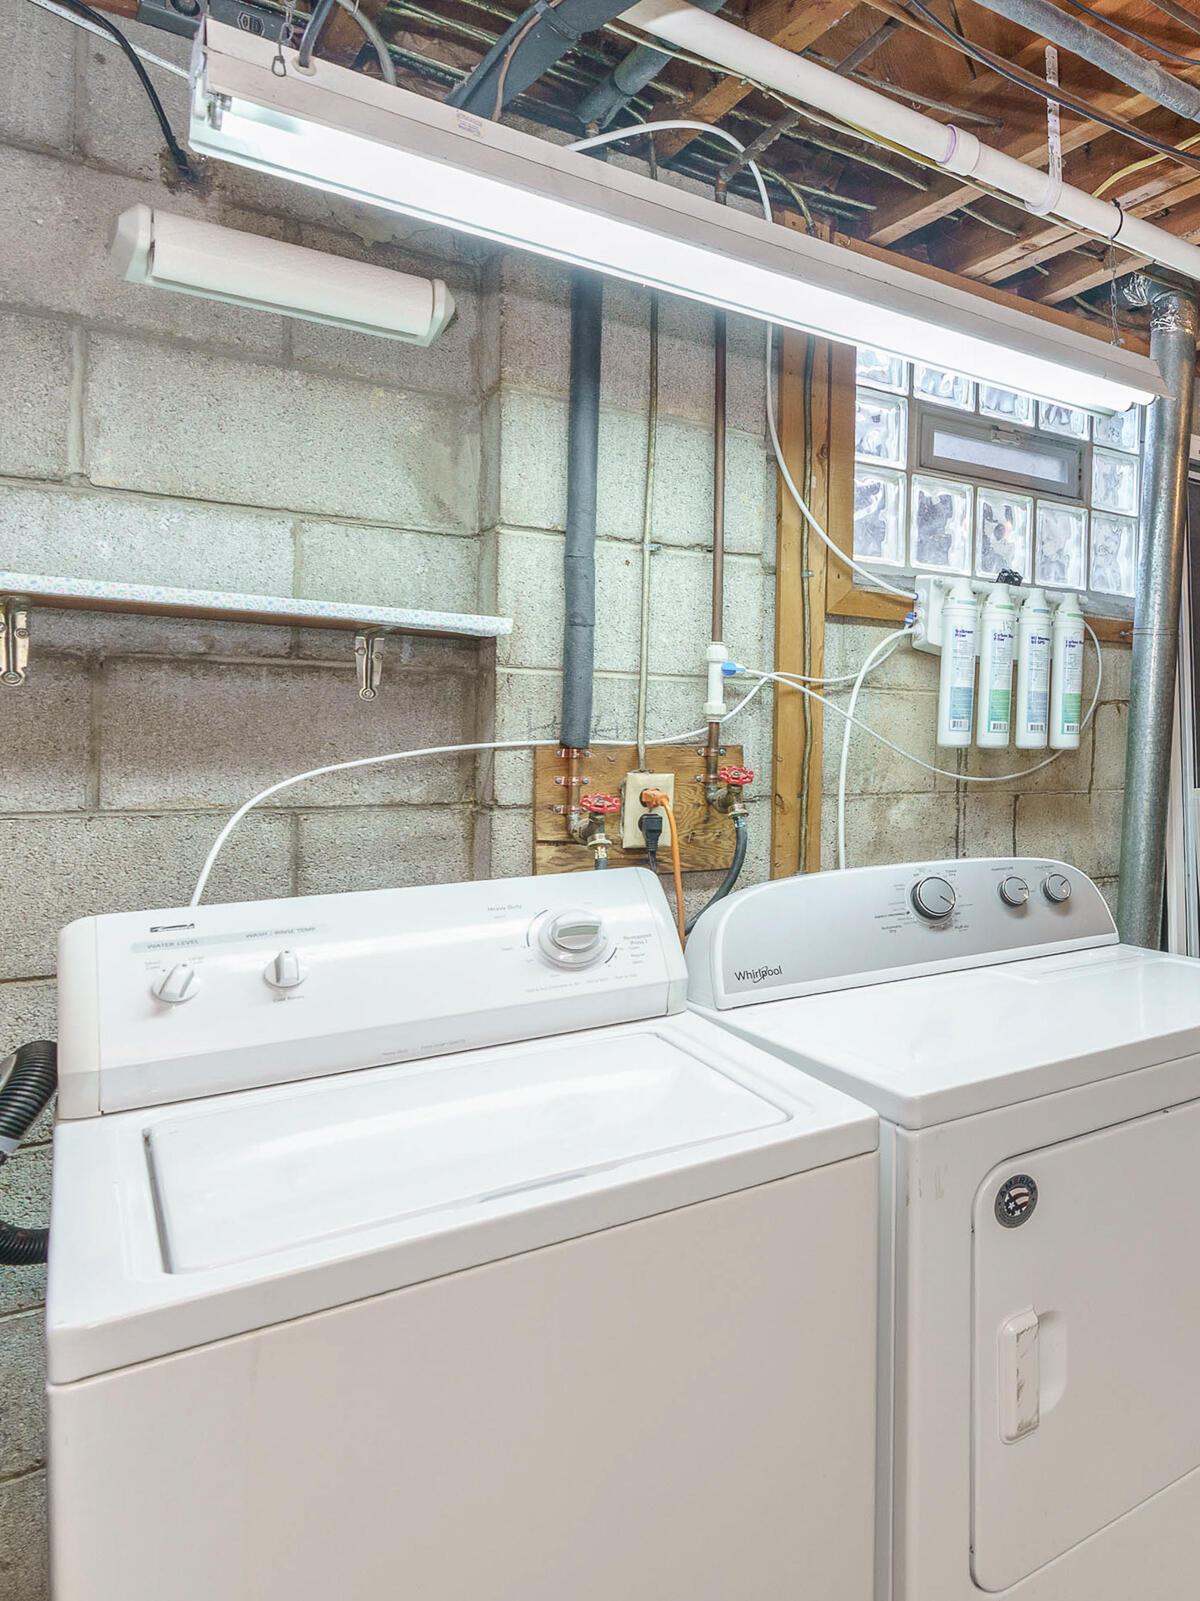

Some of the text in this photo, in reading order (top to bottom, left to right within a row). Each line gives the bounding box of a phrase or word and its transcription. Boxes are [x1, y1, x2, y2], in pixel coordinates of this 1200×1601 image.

[147, 939, 199, 950] WATER LEVEL
[734, 965, 783, 983] Whirlpool
